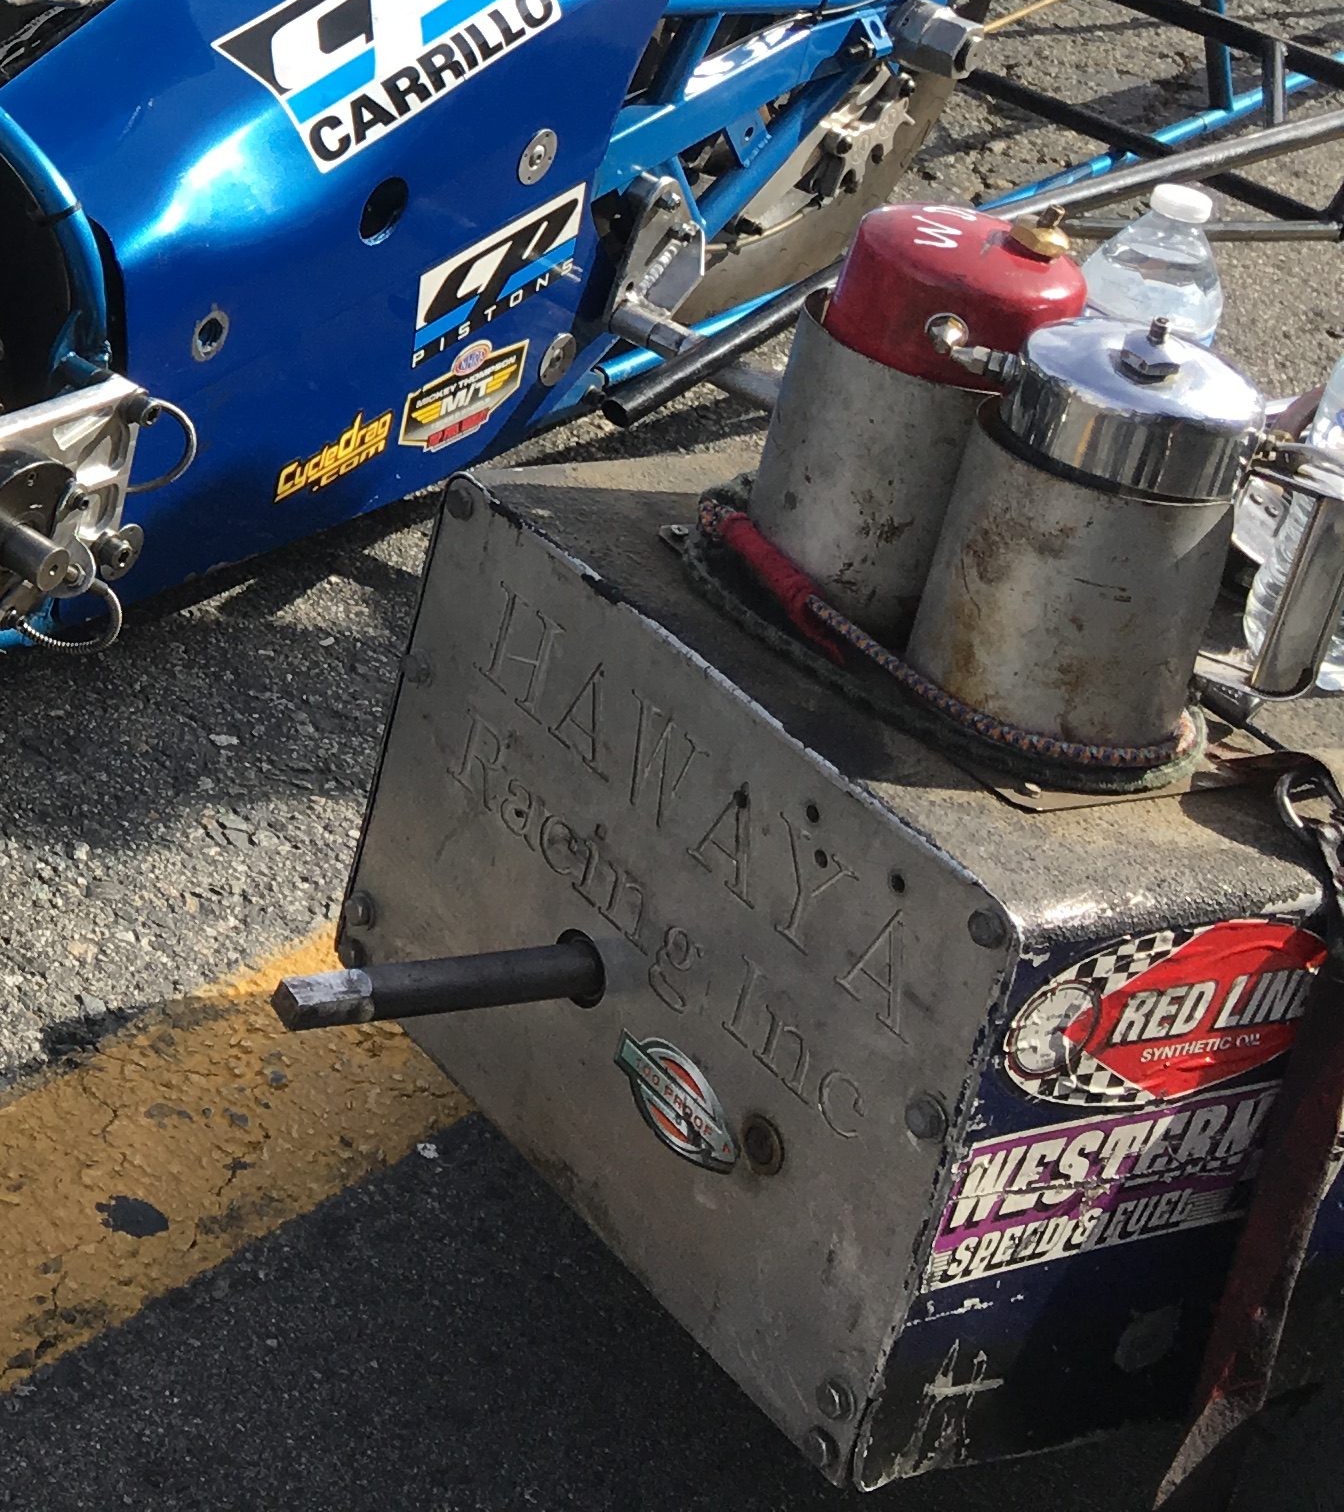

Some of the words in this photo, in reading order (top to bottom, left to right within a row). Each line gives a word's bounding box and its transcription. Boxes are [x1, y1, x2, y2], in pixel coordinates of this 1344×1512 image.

[412, 257, 574, 368] PISTONS
[458, 355, 517, 389] THOMPSON
[1111, 981, 1217, 1044] RED
[1140, 1037, 1232, 1063] SYNTHETIC
[664, 1084, 715, 1136] PROOF
[950, 1092, 1278, 1229] WESTERN
[946, 1219, 1070, 1278] SPEED
[1111, 1190, 1199, 1239] FUEL
